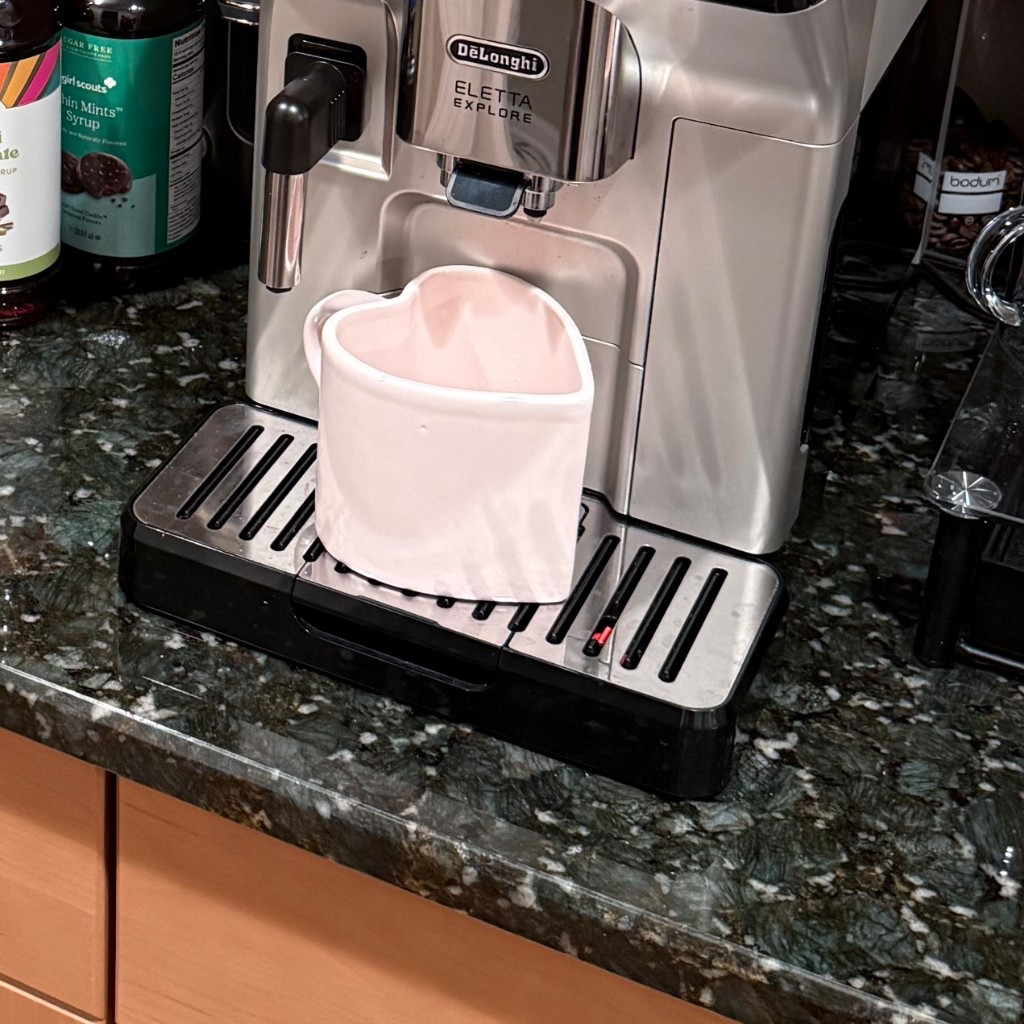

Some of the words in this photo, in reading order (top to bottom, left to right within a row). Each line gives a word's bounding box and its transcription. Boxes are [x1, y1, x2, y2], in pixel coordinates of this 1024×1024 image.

[62, 36, 85, 49] UGAR
[88, 42, 113, 54] FREE
[61, 74, 76, 86] girl
[76, 80, 108, 94] scouts
[61, 93, 78, 110] hin
[454, 80, 532, 110] ELETTA
[66, 109, 100, 132] Syrup
[453, 97, 532, 124] EXPLORE
[950, 176, 1001, 188] bodum
